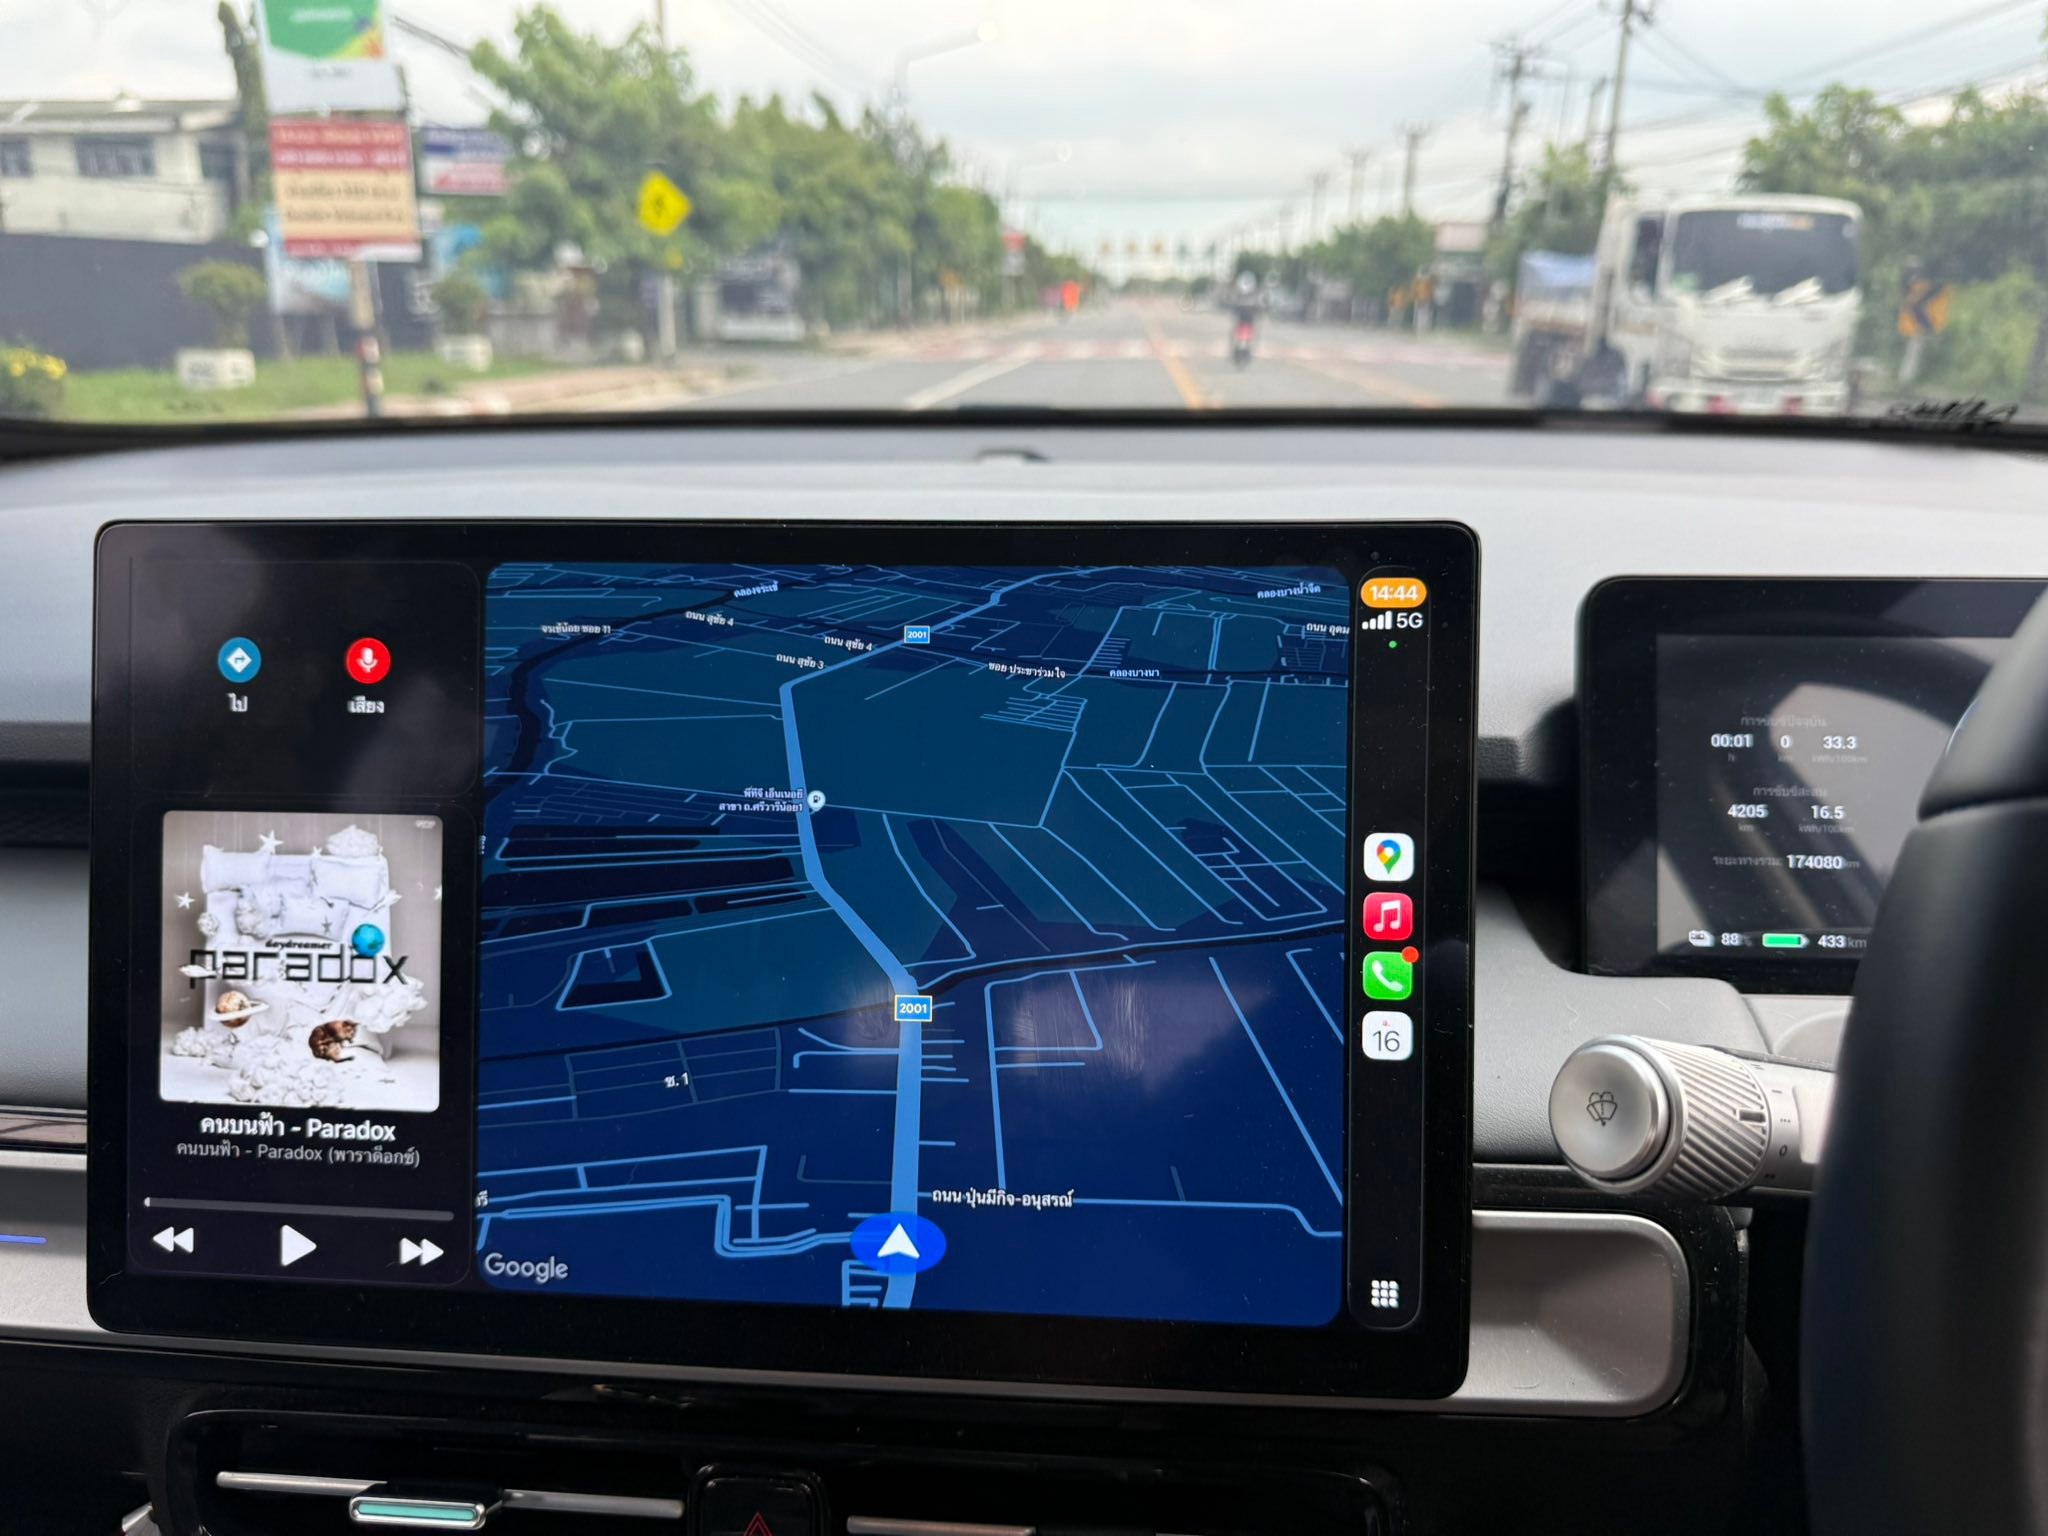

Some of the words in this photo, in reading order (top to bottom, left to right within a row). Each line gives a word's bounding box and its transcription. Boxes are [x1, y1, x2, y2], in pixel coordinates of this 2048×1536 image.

[1369, 585, 1419, 601] 14:44
[726, 617, 735, 627] 4
[1306, 622, 1327, 633] ถนน
[1396, 612, 1424, 629] 5G
[907, 630, 928, 639] 2001
[824, 635, 844, 646] ถนน
[866, 642, 873, 651] 4
[776, 653, 796, 664] ถนน
[817, 660, 825, 670] 3
[1109, 668, 1160, 678] คลองบางนา
[227, 693, 248, 712] ไป
[347, 696, 385, 714] เสียง
[1711, 734, 1752, 748] 00:01
[1780, 736, 1791, 749] 0
[1823, 736, 1857, 749] 33.3
[719, 803, 742, 812] สาขา
[1728, 804, 1767, 818] 4205
[1811, 805, 1846, 819] 16.5
[1787, 854, 1844, 870] 174080
[265, 939, 333, 952] daydreamer
[1721, 932, 1740, 946] 88
[1818, 935, 1847, 948] 433
[1848, 938, 1867, 948] km
[189, 943, 409, 989] paradox
[899, 1003, 928, 1015] 2001
[1372, 1030, 1400, 1052] 16
[681, 1072, 689, 1086] 1
[201, 1112, 285, 1136] คนบนฟ้า
[307, 1118, 397, 1142] Paradox
[177, 1140, 240, 1157] คนบนฟ้า
[258, 1144, 322, 1160] Paradox
[328, 1145, 420, 1168] (พาราด็อกซ์)
[932, 1191, 962, 1204] ถนน
[484, 1253, 568, 1284] Google
